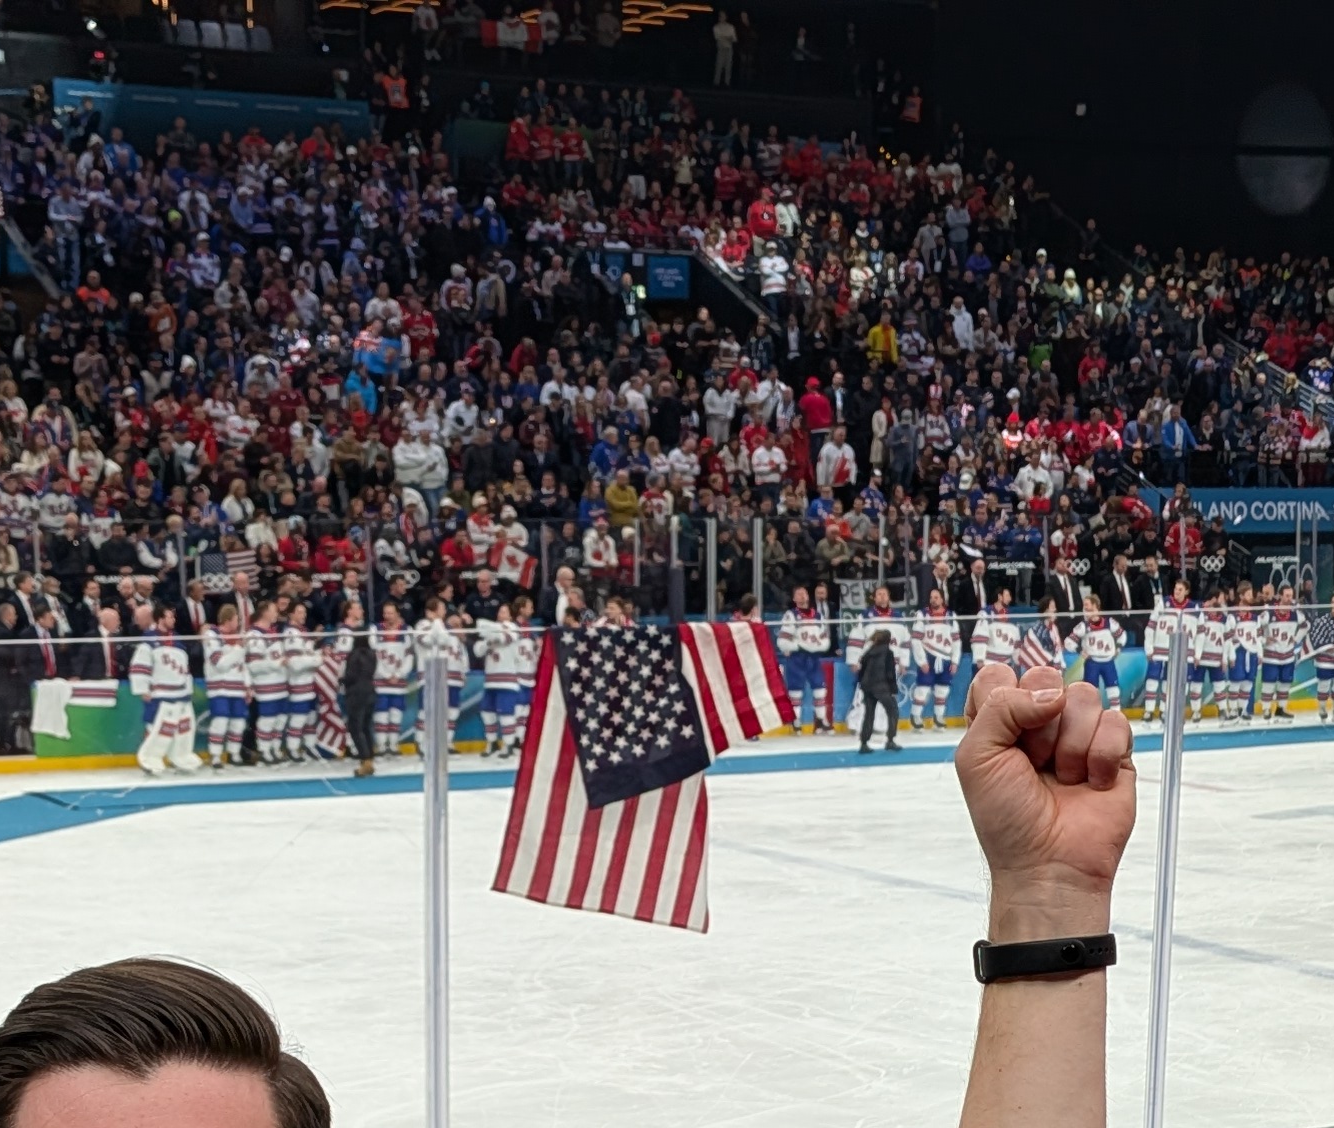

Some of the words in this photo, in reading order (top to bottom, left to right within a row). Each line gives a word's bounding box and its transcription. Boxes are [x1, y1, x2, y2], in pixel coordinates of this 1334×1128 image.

[1251, 499, 1330, 521] CORTINA
[926, 629, 951, 647] USA
[1088, 636, 1111, 652] USA
